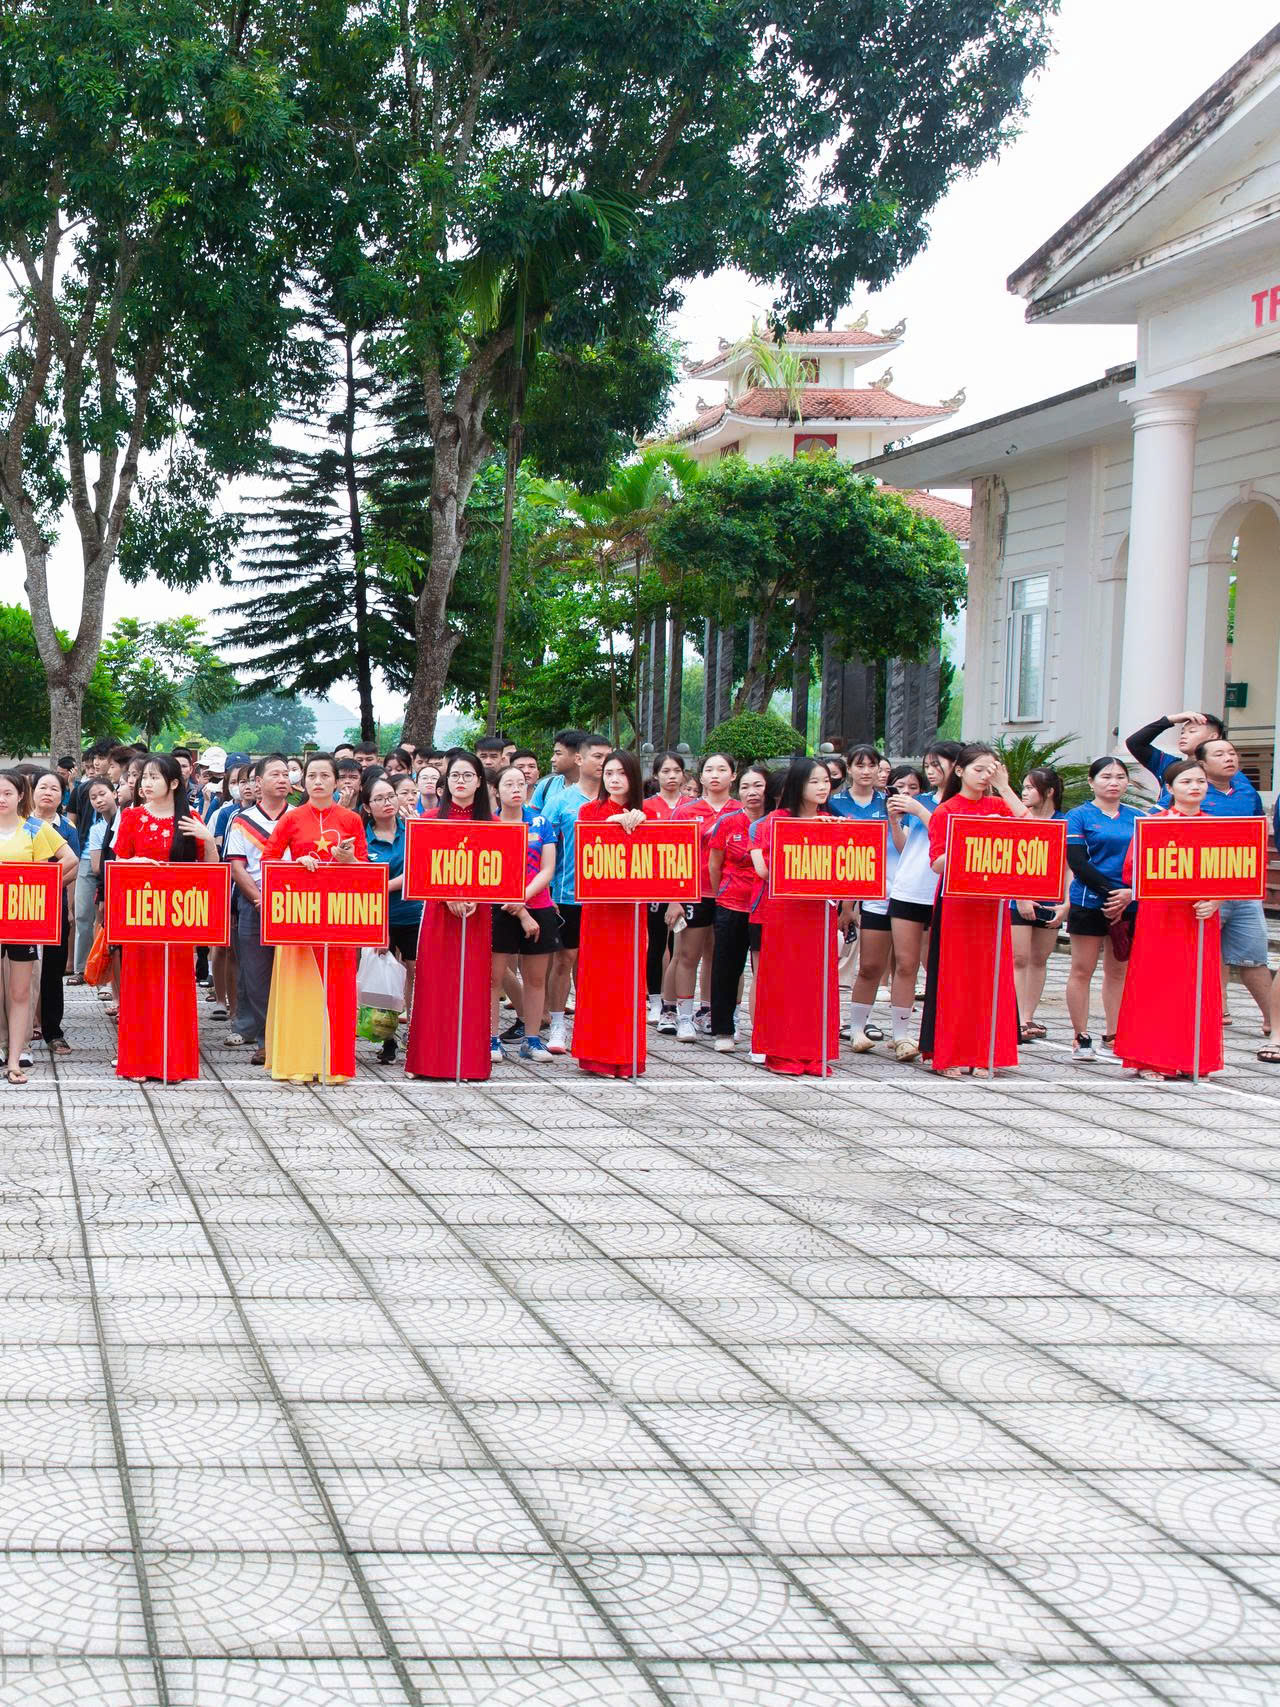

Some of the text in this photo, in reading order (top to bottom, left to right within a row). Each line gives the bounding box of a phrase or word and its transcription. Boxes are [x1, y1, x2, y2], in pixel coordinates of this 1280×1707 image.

[431, 837, 503, 886] KHỐI GD
[583, 836, 693, 888] CÔNG AN TRẠI
[783, 837, 876, 882] THÀNH CÔNG
[965, 837, 1049, 881] THẠCH SƠN
[1146, 841, 1257, 880] LIÊN MINH
[7, 876, 46, 921] BÌNH
[126, 882, 209, 927] LIÊN SƠN
[271, 884, 382, 925] BÌNH MINH
[686, 905, 694, 920] 3
